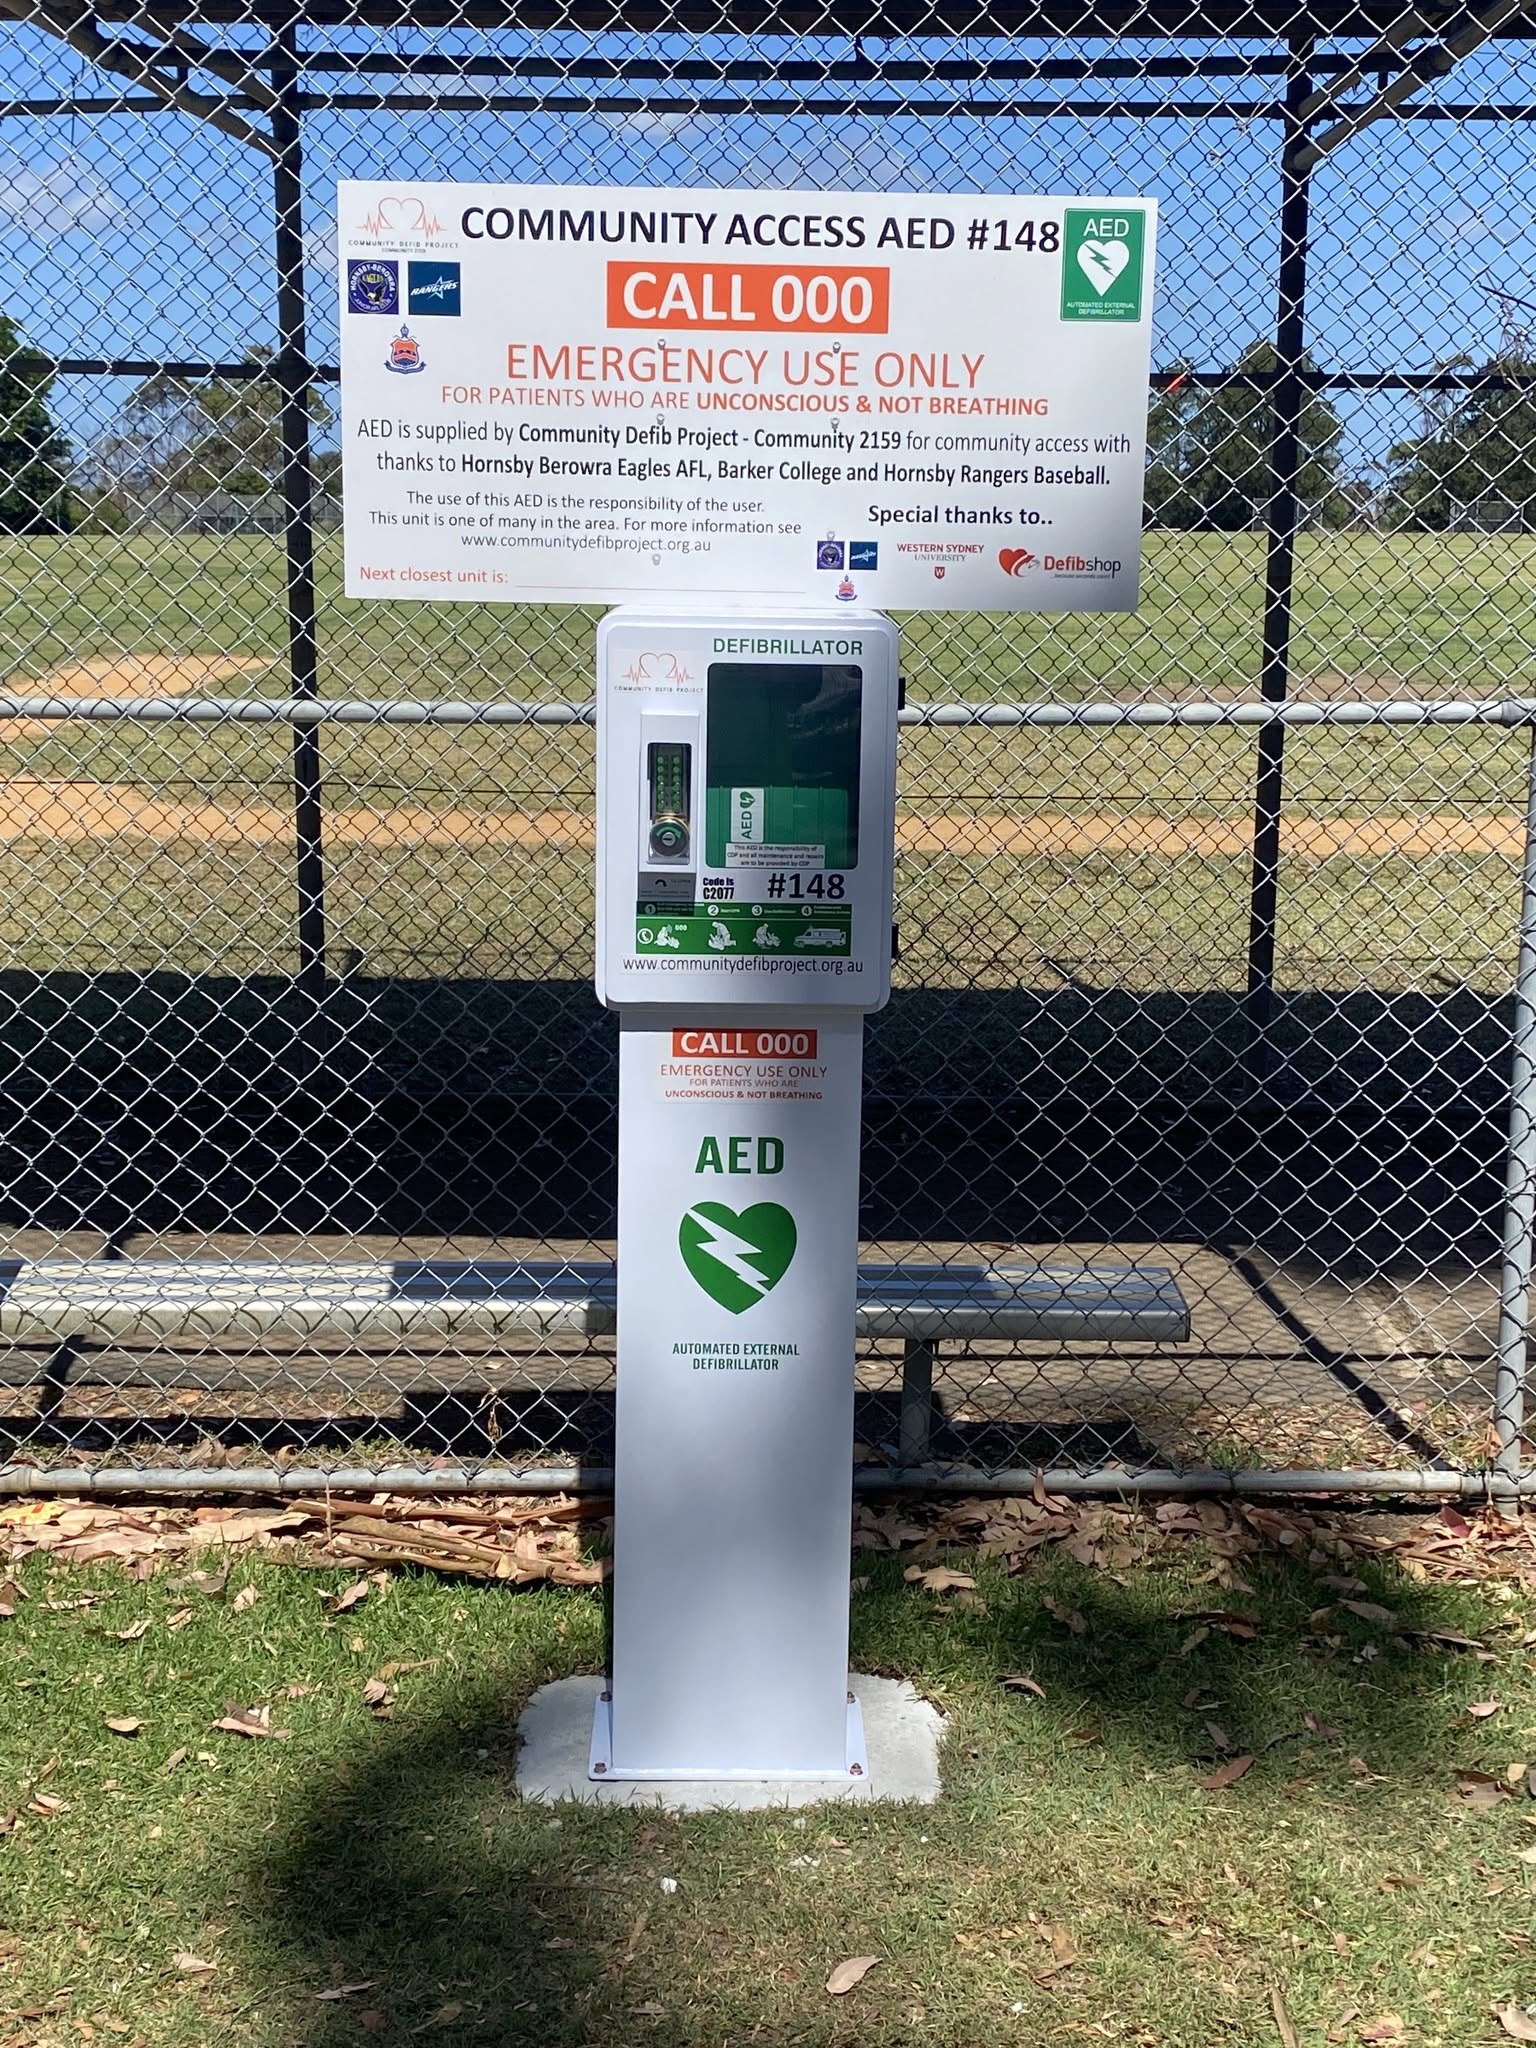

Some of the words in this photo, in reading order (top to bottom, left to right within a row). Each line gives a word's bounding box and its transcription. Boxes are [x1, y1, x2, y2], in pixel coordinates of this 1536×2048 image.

[461, 207, 717, 244] COMMUNITY
[724, 213, 865, 248] ACCESS
[877, 217, 954, 249] AED
[967, 219, 1058, 252] #148
[1083, 218, 1128, 236] AED
[410, 282, 459, 296] RANGERS
[624, 271, 755, 321] CALL
[772, 274, 872, 324] 000
[508, 343, 768, 385] EMERGENCY
[784, 349, 859, 387] USE
[875, 352, 985, 389] ONLY
[442, 386, 481, 403] FOR
[489, 387, 584, 406] PATIENTS
[592, 390, 643, 408] WHO
[650, 391, 688, 409] ARE
[697, 392, 848, 412] UNCONSCIOUS
[856, 395, 871, 412] &
[879, 396, 923, 413] NOT
[930, 396, 1047, 416] BREATHING
[358, 419, 392, 437] AED
[398, 419, 410, 438] is
[416, 419, 486, 444] supplied
[494, 421, 513, 445] by
[519, 423, 620, 448] Community
[626, 423, 671, 444] Defib
[678, 426, 738, 451] Project
[754, 428, 854, 453] Community
[860, 431, 900, 449] 2159
[906, 430, 930, 449] for
[935, 431, 1030, 455] community
[1035, 438, 1088, 452] access
[1094, 433, 1129, 453] with
[377, 451, 433, 471] thanks
[438, 455, 455, 471] to
[462, 453, 533, 478] Hornsby
[540, 456, 611, 475] Berowra
[618, 457, 670, 481] Eagles
[676, 459, 711, 481] AFL,
[718, 459, 773, 479] Barker
[779, 460, 840, 484] College
[847, 461, 877, 481] and
[885, 462, 955, 486] Hornsby
[961, 465, 1027, 488] Rangers
[1034, 464, 1109, 484] Baseball.
[406, 490, 432, 504] The
[438, 495, 461, 505] use
[466, 492, 480, 505] of
[484, 492, 509, 506] this
[514, 493, 542, 507] AED
[548, 495, 557, 507] is
[561, 494, 584, 508] the
[590, 495, 682, 513] responsibility
[686, 497, 701, 510] of
[705, 497, 727, 511] the
[732, 500, 765, 512] user.
[369, 511, 397, 524] This
[402, 512, 429, 525] unit
[434, 513, 444, 525] is
[448, 516, 474, 526] one
[480, 513, 494, 527] of
[498, 517, 536, 531] many
[541, 515, 552, 528] in
[557, 515, 580, 529] the
[585, 519, 619, 532] area.
[624, 517, 646, 530] For
[651, 521, 686, 531] more
[692, 518, 772, 533] information
[778, 523, 801, 533] see
[868, 503, 937, 527] Special
[944, 505, 1012, 524] thanks
[1019, 509, 1052, 524] to..
[461, 534, 711, 553] www.communitydefibproject.org.au
[897, 544, 943, 552] WESTERN
[946, 544, 985, 553] SYDNEY
[914, 553, 967, 562] UNIVERSITY
[1043, 555, 1121, 579] Defibshop
[360, 566, 394, 580] Next
[400, 567, 452, 581] closest
[458, 569, 487, 582] unit
[492, 570, 508, 583] is:
[714, 637, 862, 656] DEFIBRILLATOR
[741, 811, 752, 839] AED
[703, 877, 724, 886] Code
[767, 873, 844, 899] #148
[703, 887, 735, 899] C2077
[623, 957, 864, 975] www.communitydefibproject.org.au
[681, 1032, 748, 1054] CALL
[757, 1033, 808, 1054] 000
[661, 1064, 751, 1077] EMERGENCY
[757, 1065, 783, 1077] USE
[788, 1066, 826, 1077] ONLY
[690, 1078, 707, 1086] FOR
[710, 1078, 752, 1086] PATIENTS
[754, 1079, 778, 1087] WHO
[781, 1079, 798, 1087] ARE
[665, 1090, 734, 1098] UNCONSCIOUS
[736, 1090, 743, 1098] &
[769, 1091, 822, 1099] BREATHING
[695, 1136, 783, 1174] AED
[672, 1343, 739, 1354] AUTOMATED
[744, 1343, 799, 1355] EXTERNAL
[693, 1358, 778, 1370] DEFIBRILLATOR
